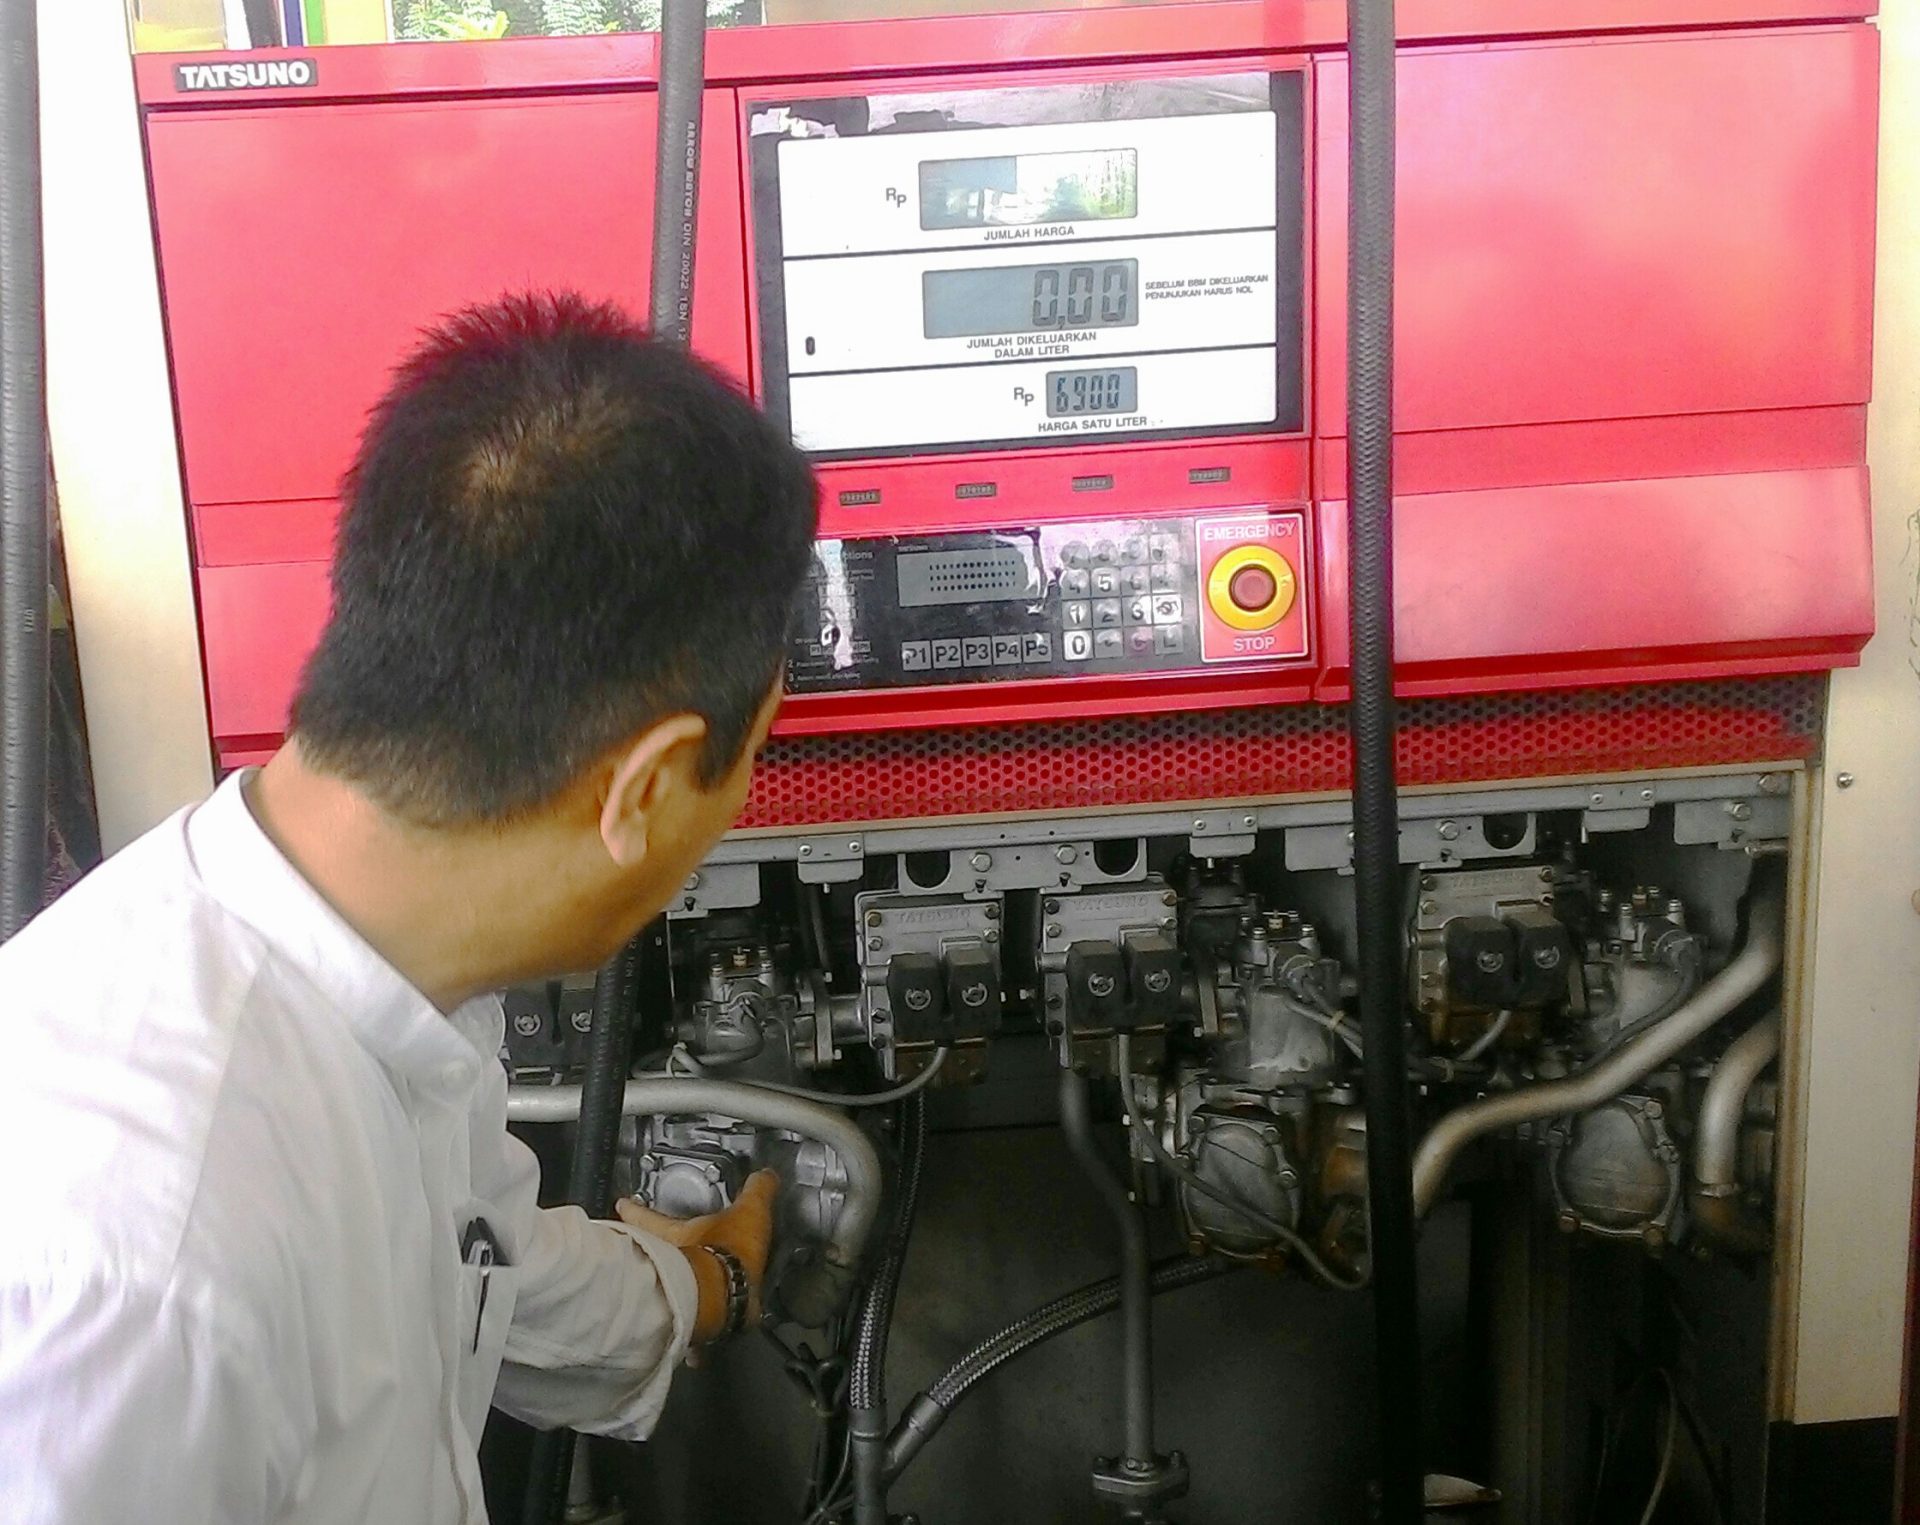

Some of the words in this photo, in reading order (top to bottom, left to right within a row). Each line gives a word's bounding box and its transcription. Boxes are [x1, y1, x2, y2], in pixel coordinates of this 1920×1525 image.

[179, 61, 310, 89] TATSUNO
[984, 229, 1030, 241] JUMLAH
[1034, 226, 1075, 237] HARGA
[680, 252, 691, 290] 20022
[1145, 280, 1185, 290] SEBELUM
[1209, 275, 1269, 286] DIKELUARKAN
[1204, 287, 1233, 296] HARUS
[1236, 286, 1253, 294] NOL
[967, 336, 1013, 349] JUMLAH
[1017, 332, 1097, 346] DIKELUARKAN
[994, 347, 1034, 359] DALAM
[1038, 345, 1070, 356] LITER
[1056, 374, 1120, 412] 6900
[1038, 421, 1078, 433] HARGA
[1082, 419, 1112, 430] SATU
[1116, 416, 1147, 427] LITER
[1204, 522, 1297, 541] EMERGENCY
[1098, 573, 1112, 593] 5
[965, 644, 989, 660] P3
[995, 642, 1019, 659] P4
[1072, 635, 1086, 656] 0
[1233, 636, 1276, 652] STOP
[936, 647, 960, 663] P2
